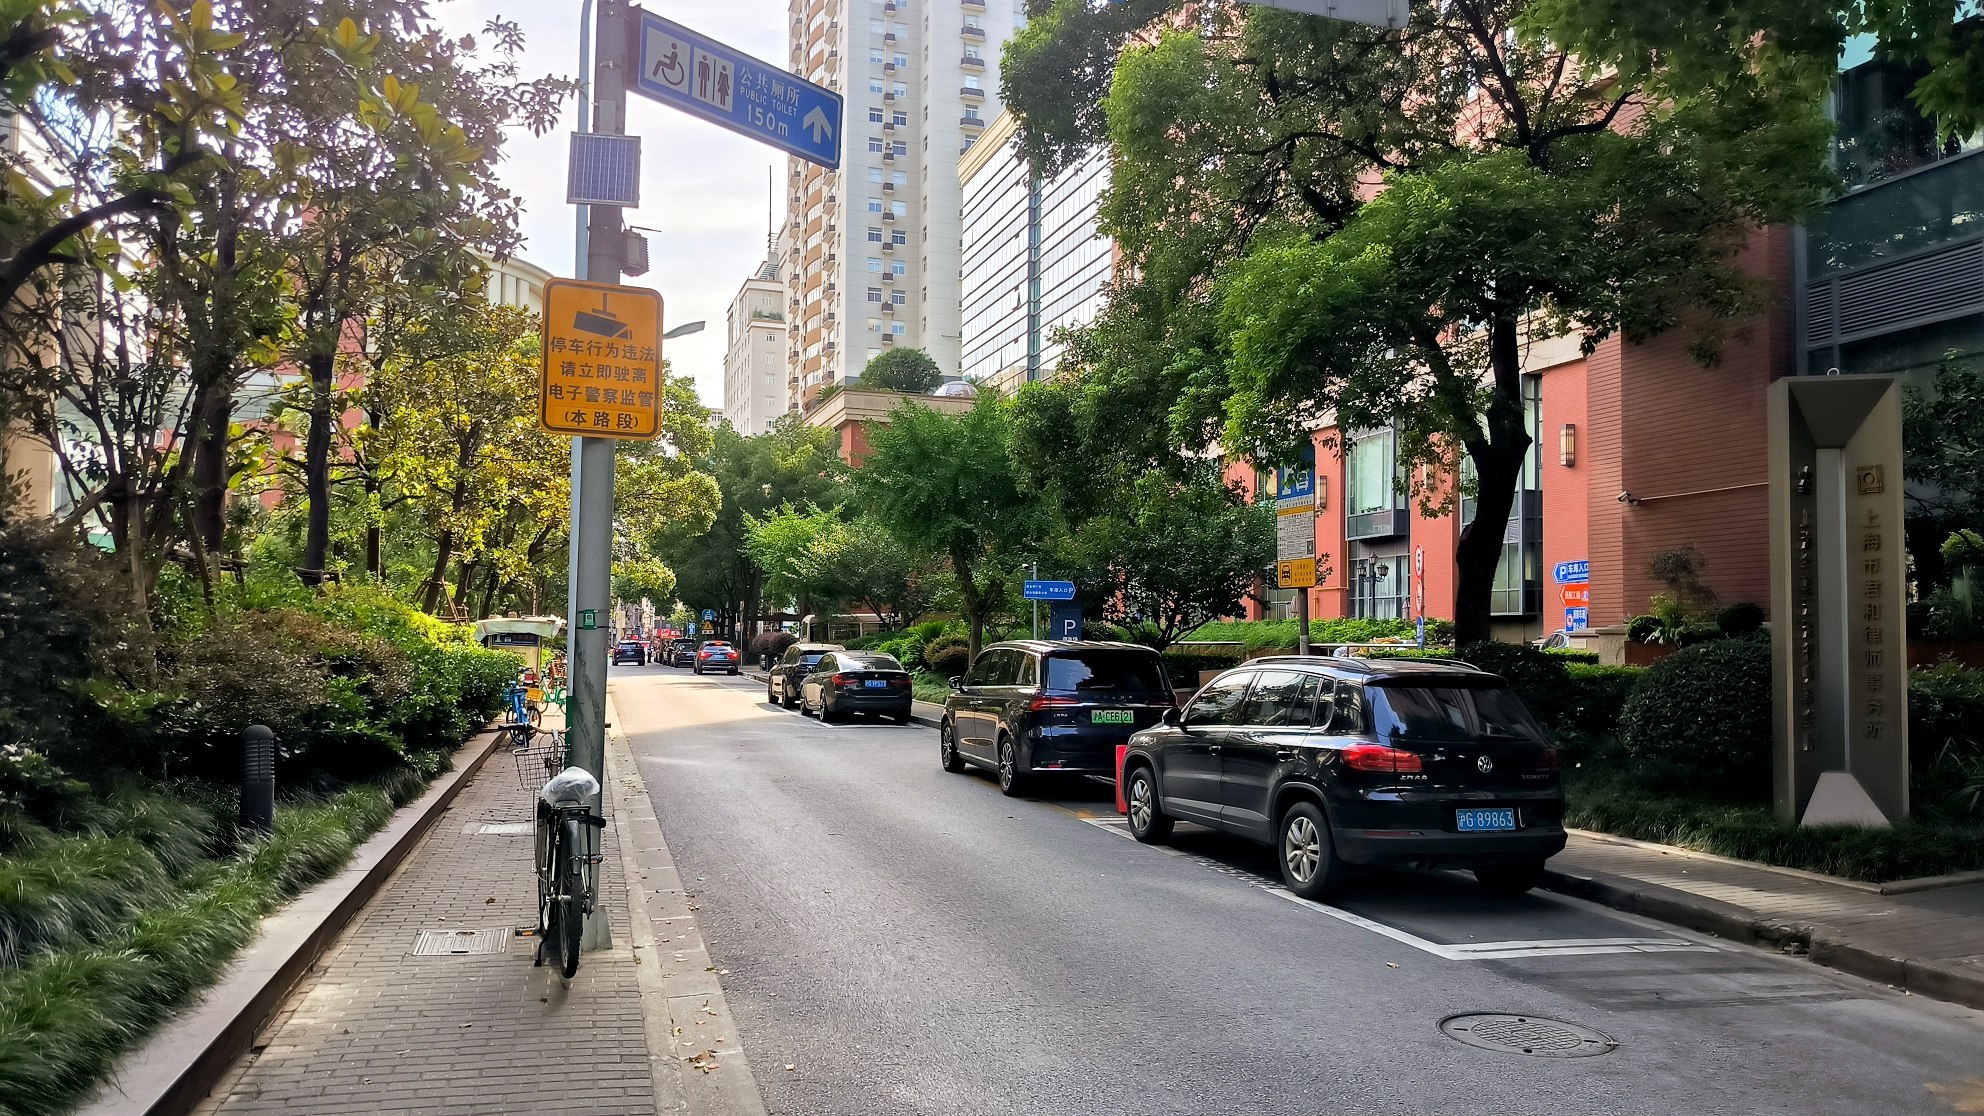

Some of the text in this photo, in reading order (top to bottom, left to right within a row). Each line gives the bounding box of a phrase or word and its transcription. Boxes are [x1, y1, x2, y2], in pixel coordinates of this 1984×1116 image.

[739, 66, 800, 107] 公共厕所
[740, 86, 797, 118] PUBLIC TOILET
[746, 104, 788, 137] 150m
[550, 336, 655, 362] 停车行为违法
[560, 360, 647, 383] 请立即驶离
[549, 383, 654, 408] 电子警察监管
[1559, 566, 1567, 580] P
[1064, 619, 1076, 635] P
[1863, 508, 1883, 739] 上海市君和律师事务所
